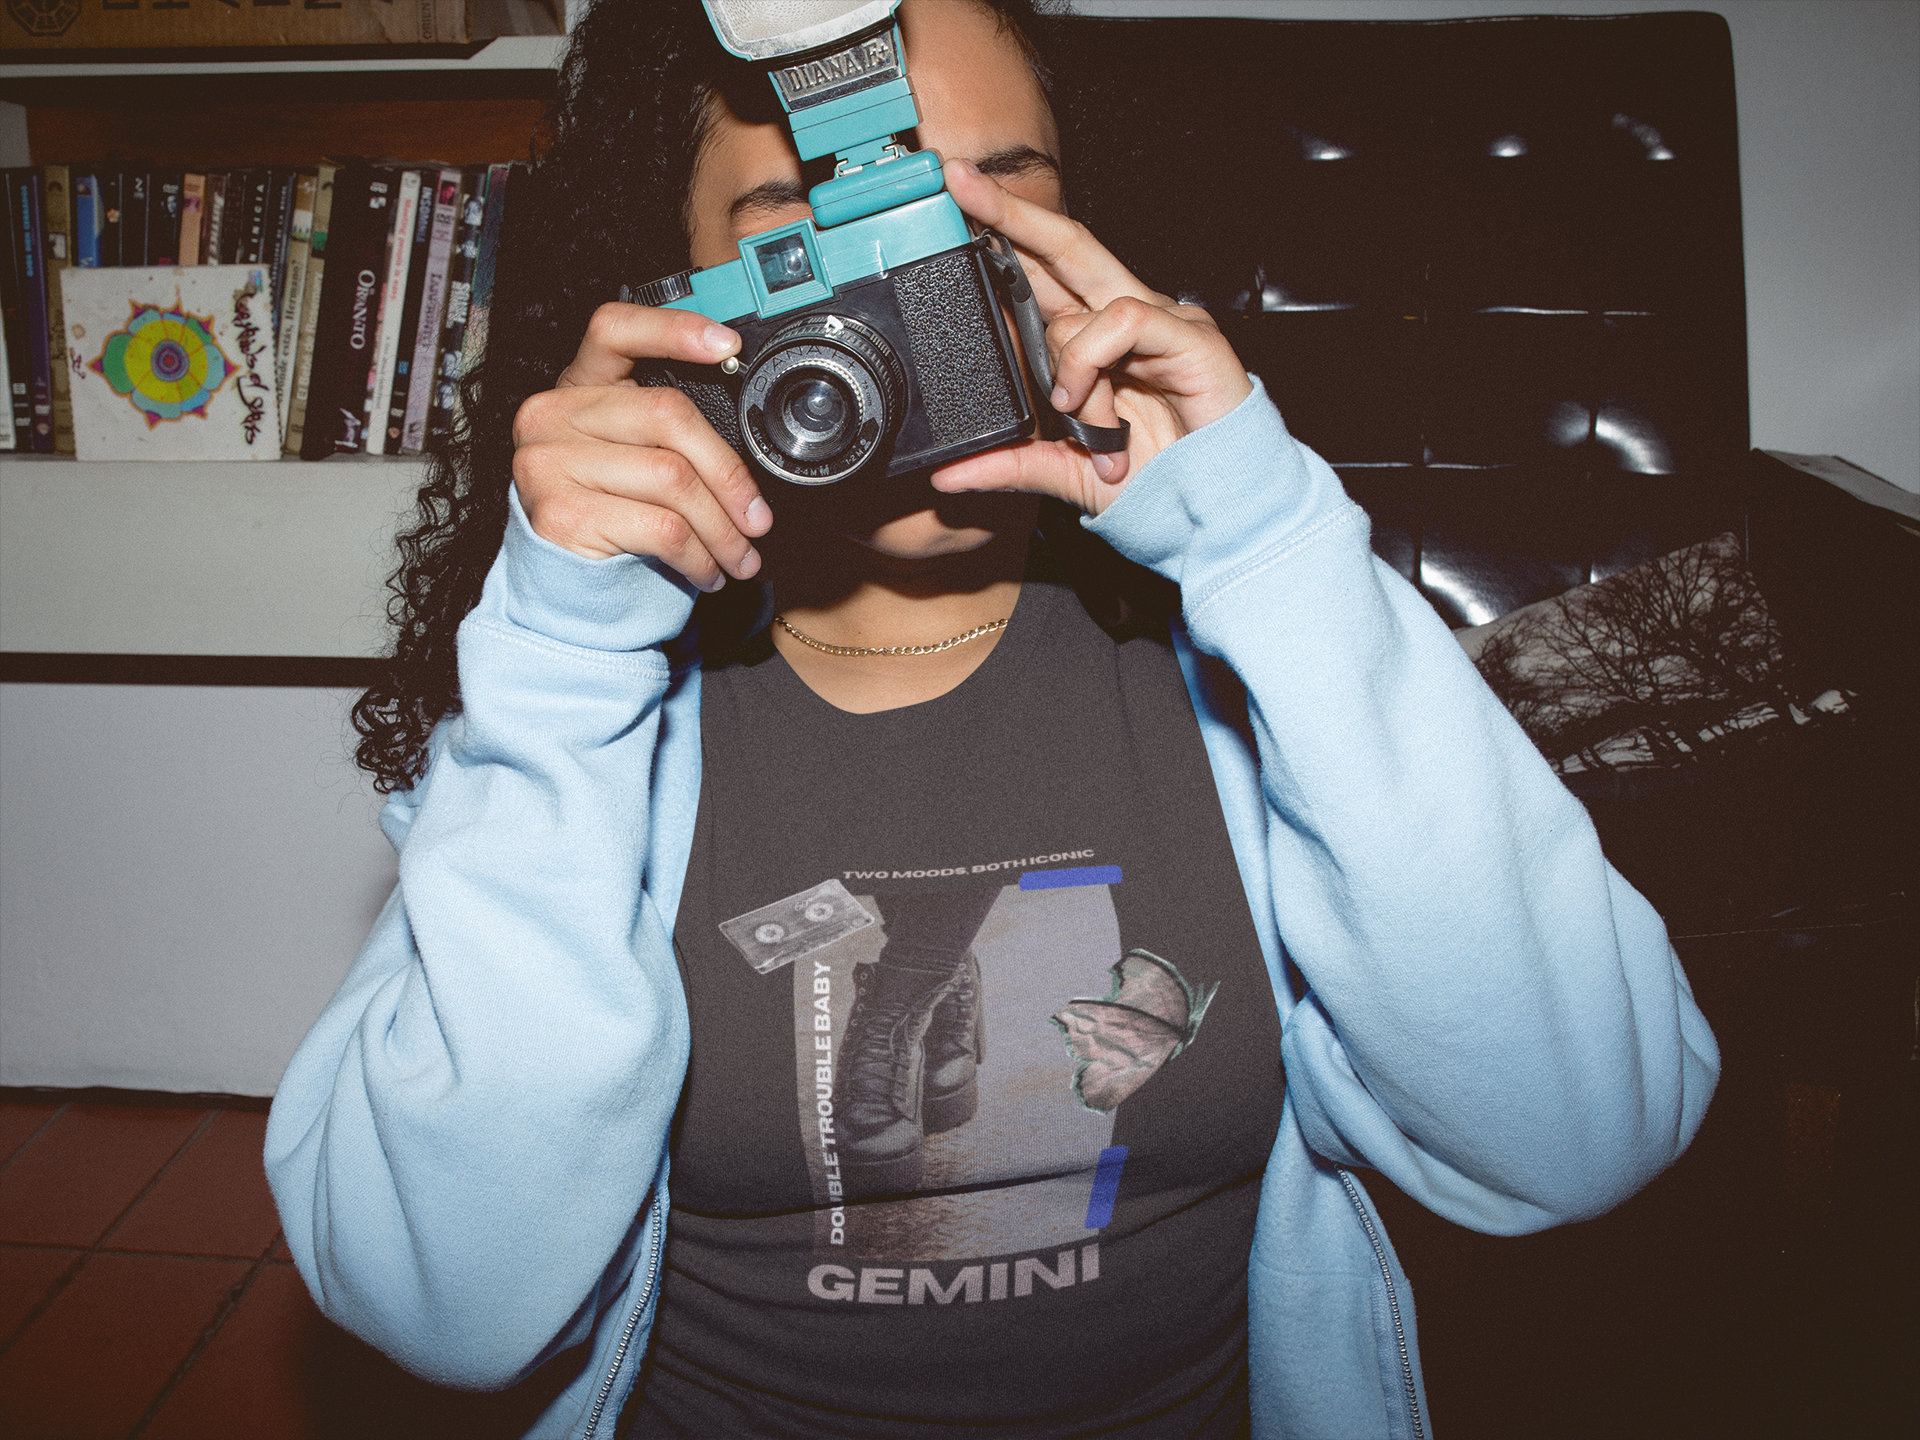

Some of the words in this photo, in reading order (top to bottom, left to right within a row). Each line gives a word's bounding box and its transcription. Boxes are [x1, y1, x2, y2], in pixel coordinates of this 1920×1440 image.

[421, 0, 432, 40] ORIEN
[783, 49, 864, 92] DIANA
[861, 38, 889, 67] F+
[416, 186, 433, 242] INSOMNIA
[754, 345, 822, 393] DIANA
[843, 871, 889, 879] TWO
[971, 858, 1027, 874] BOTH
[1029, 849, 1096, 865] ICONIC
[813, 961, 832, 1031] BABY
[816, 1036, 837, 1145] TROUBLE
[807, 1242, 1100, 1305] GEMINI
